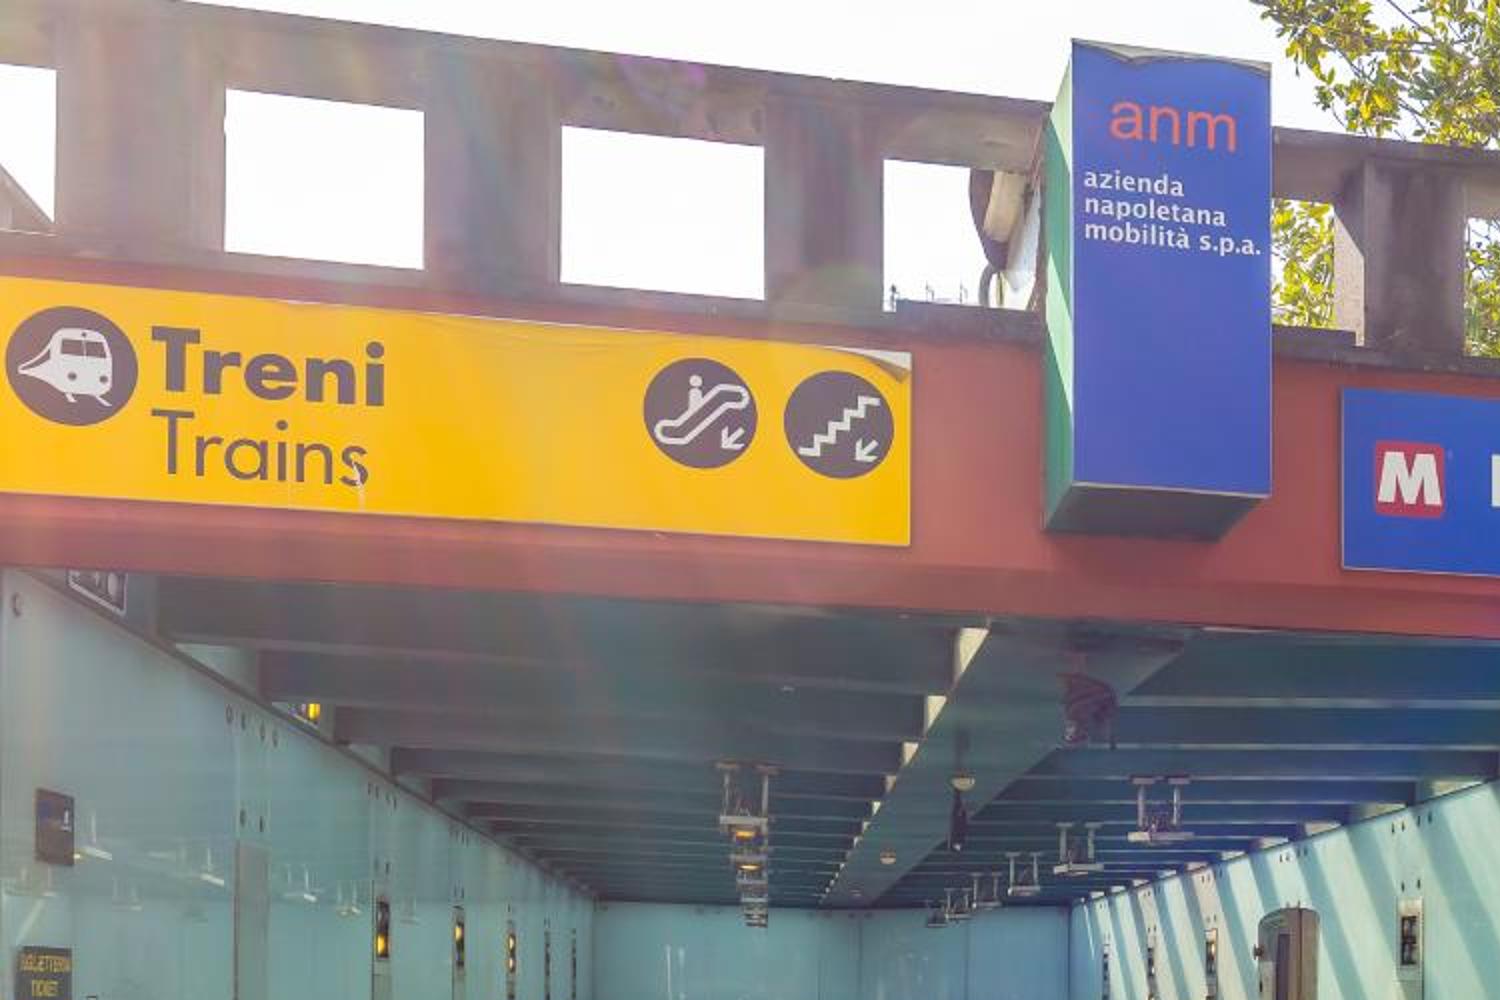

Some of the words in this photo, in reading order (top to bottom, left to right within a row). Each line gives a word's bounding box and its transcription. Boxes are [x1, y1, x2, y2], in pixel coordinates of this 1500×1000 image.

[1110, 102, 1236, 152] anm
[1084, 169, 1185, 198] azienda
[1085, 195, 1227, 228] napoletana
[1085, 222, 1190, 249] mobilità
[1199, 233, 1262, 257] s.p.a.
[151, 325, 386, 407] Treni
[151, 408, 369, 488] Trains
[1377, 451, 1442, 506] M
